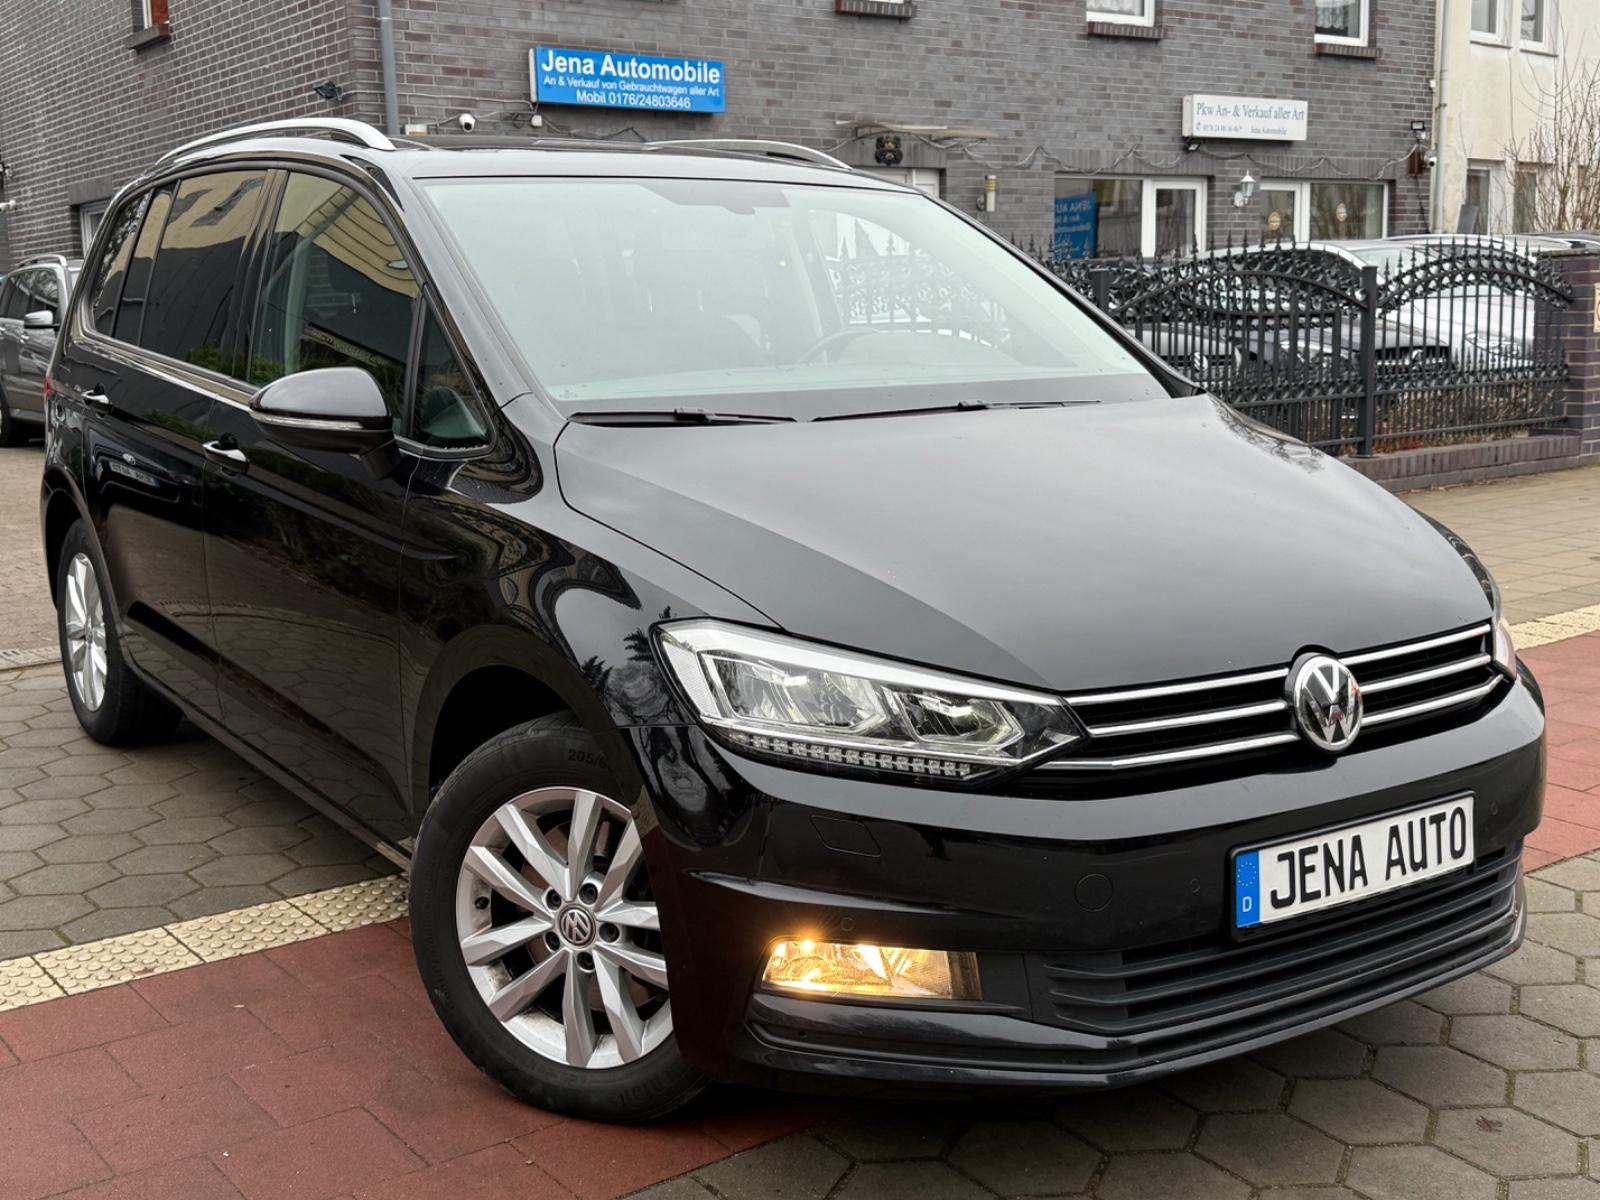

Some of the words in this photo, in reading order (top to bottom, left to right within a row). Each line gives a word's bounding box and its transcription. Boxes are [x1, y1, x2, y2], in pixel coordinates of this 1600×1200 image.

[541, 50, 595, 75] Jena
[600, 55, 720, 84] Automobile
[544, 76, 556, 85] An
[558, 77, 565, 86] &
[566, 77, 600, 89] Verkauf
[602, 82, 617, 90] von
[619, 81, 687, 96] Gebrauchtwagen
[689, 86, 706, 96] aller
[707, 87, 719, 97] Art
[577, 90, 606, 104] Mobil
[608, 93, 691, 109] 0176/24803646
[1196, 103, 1214, 116] Pkw
[1232, 104, 1240, 117] &
[1242, 105, 1273, 119] Verkauf
[1273, 107, 1291, 120] aller
[1291, 108, 1304, 120] Art
[1270, 834, 1368, 910] JENA
[1385, 806, 1467, 881] AUTO
[1242, 896, 1252, 912] D
